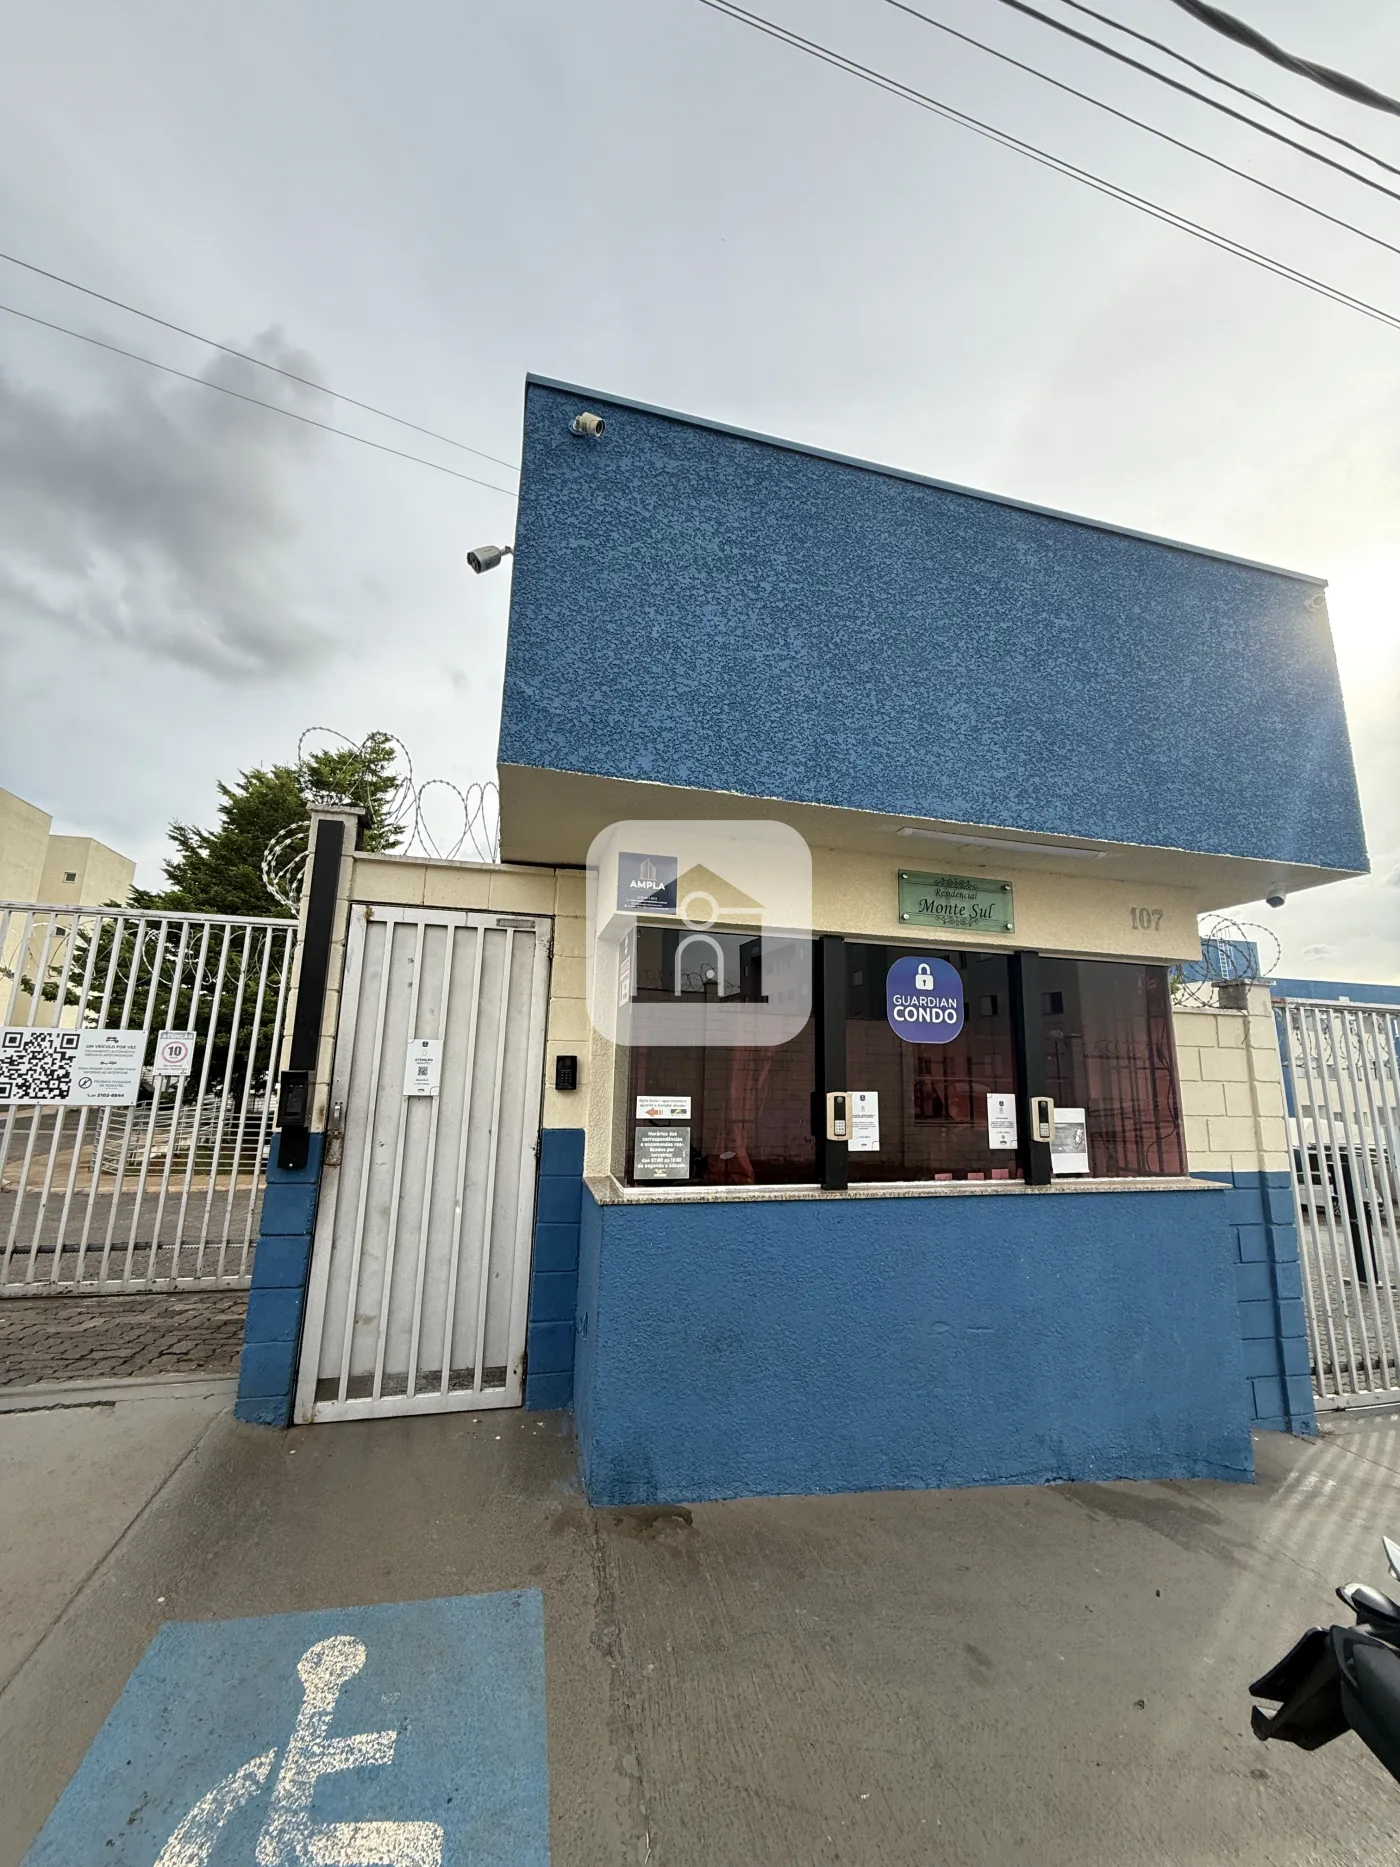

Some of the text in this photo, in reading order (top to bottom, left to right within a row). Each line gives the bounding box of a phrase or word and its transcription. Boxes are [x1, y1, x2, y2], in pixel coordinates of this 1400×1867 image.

[630, 880, 666, 890] AMPLA
[935, 888, 978, 900] Residencial
[918, 898, 995, 919] Monte Sul
[1130, 906, 1164, 931] 107
[893, 994, 956, 1008] GUARDIAN
[893, 1006, 957, 1024] CONDO
[168, 1046, 182, 1056] 10
